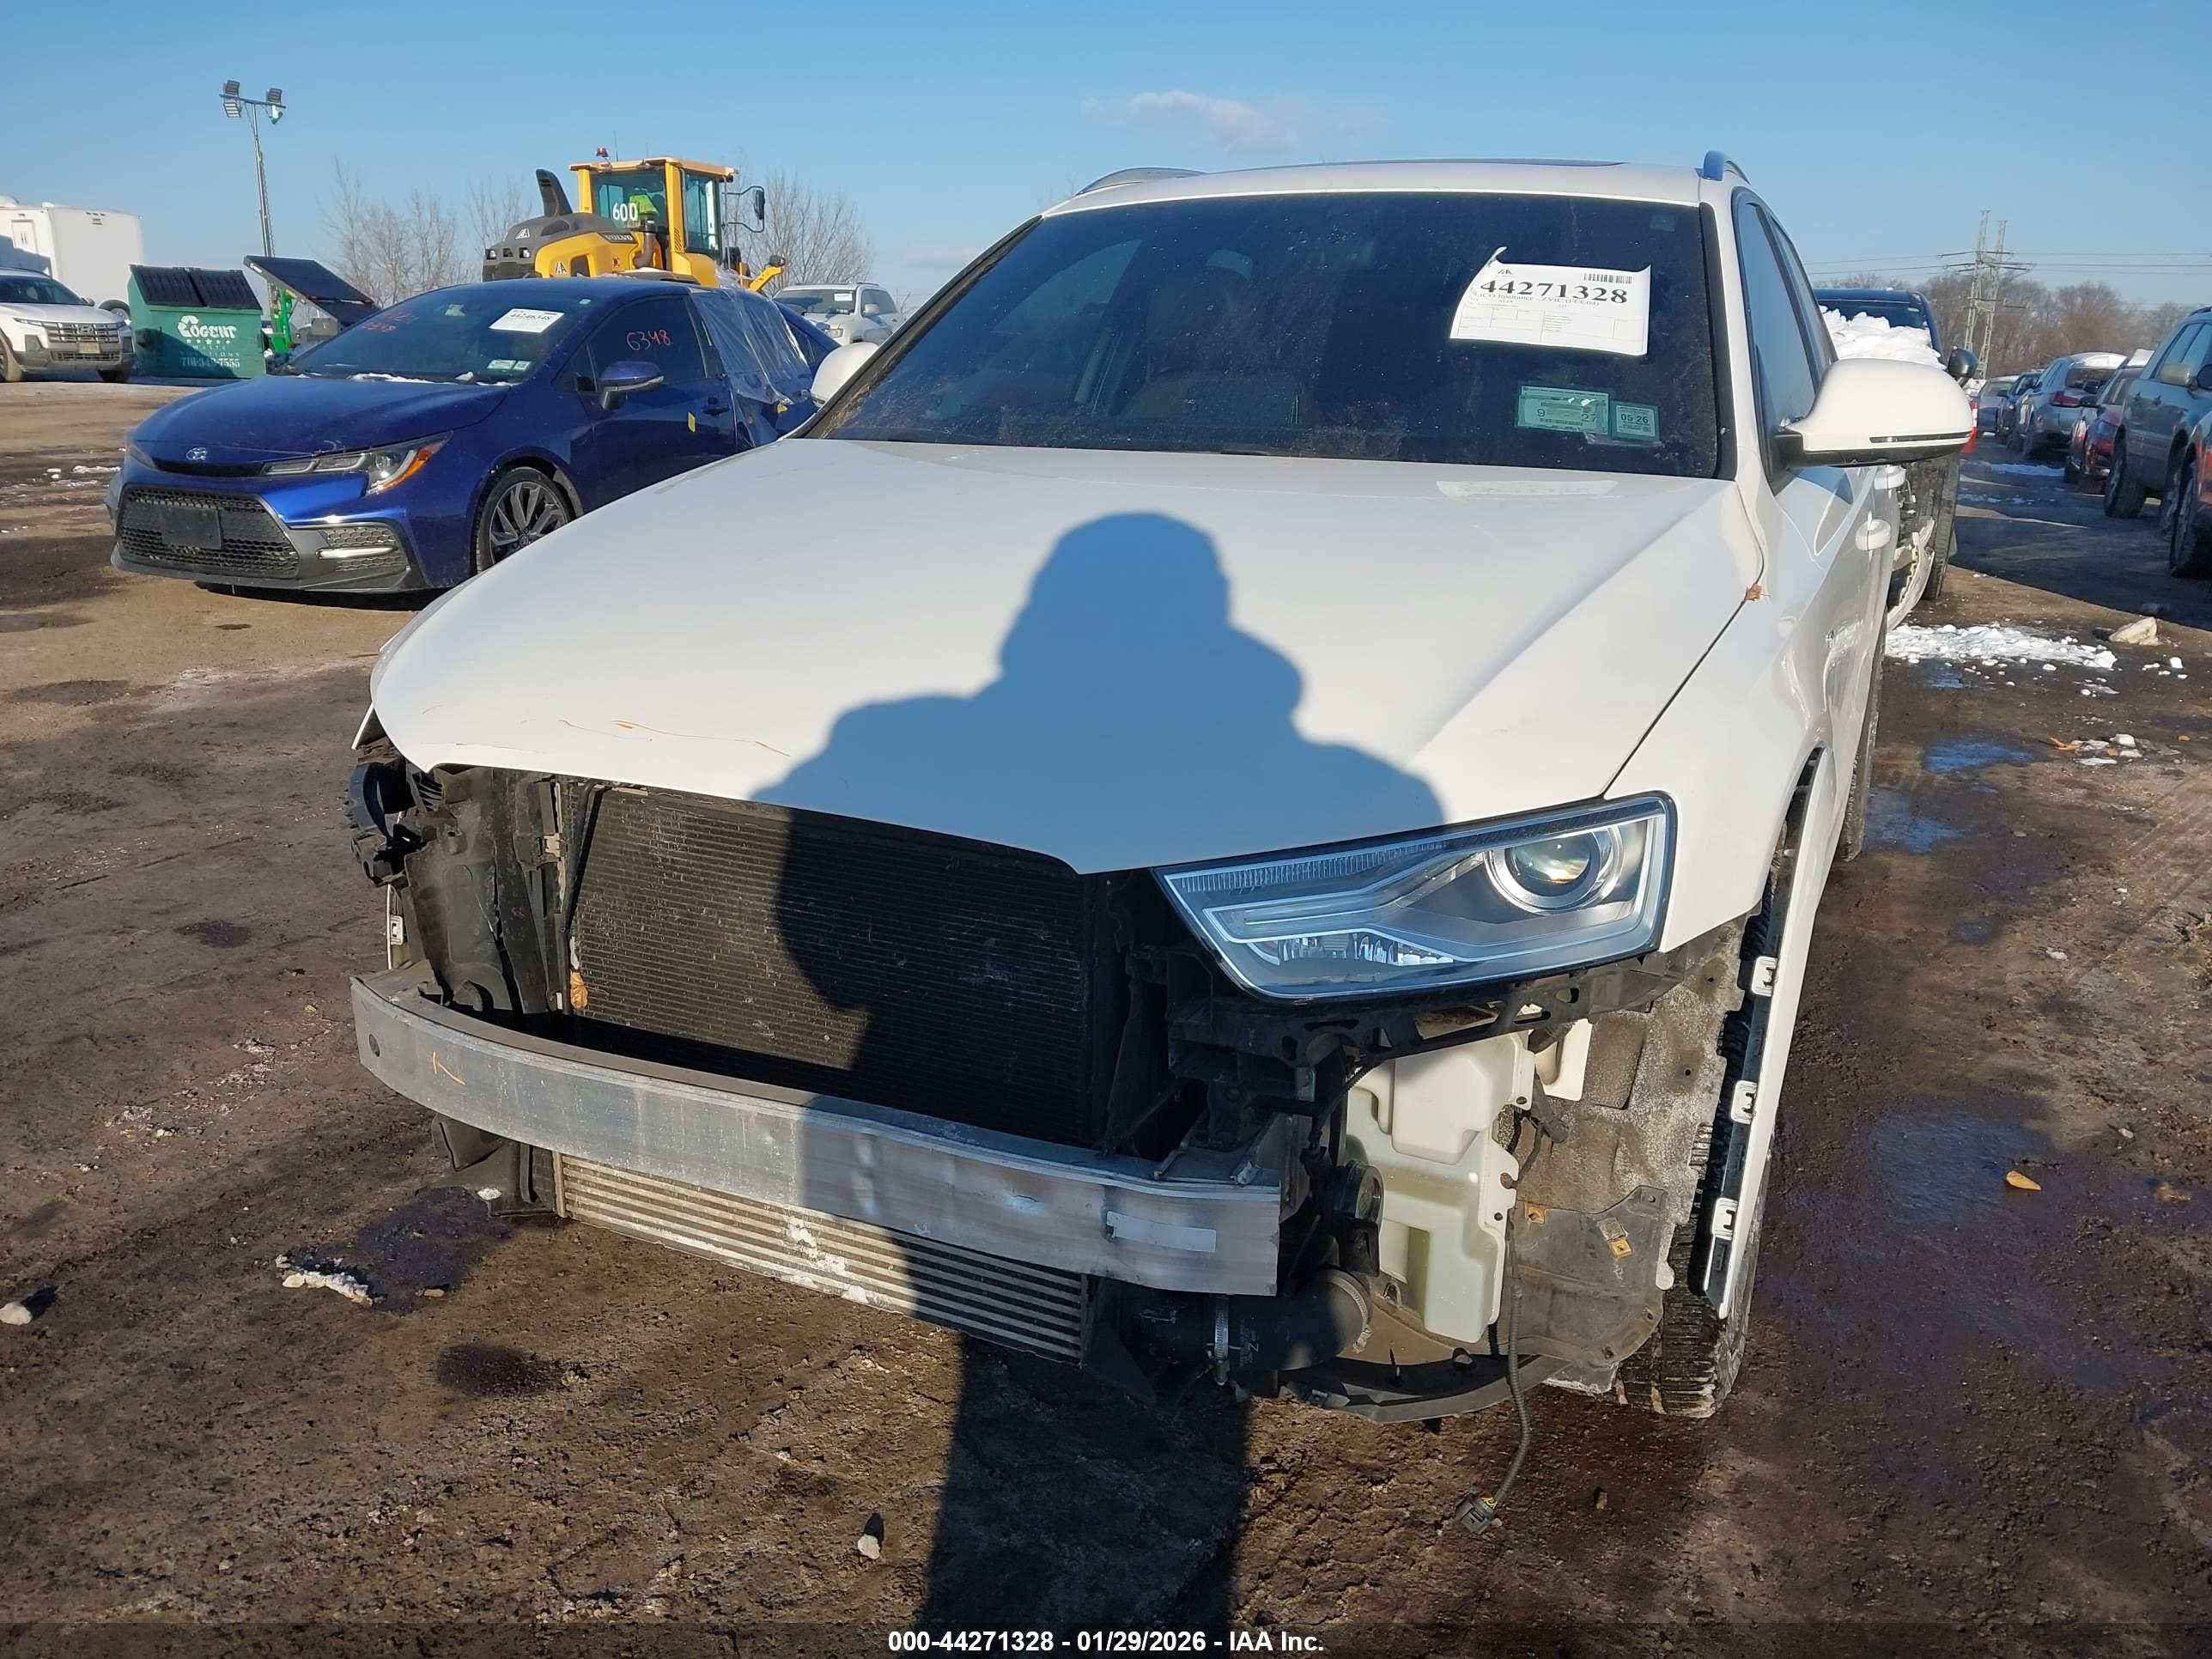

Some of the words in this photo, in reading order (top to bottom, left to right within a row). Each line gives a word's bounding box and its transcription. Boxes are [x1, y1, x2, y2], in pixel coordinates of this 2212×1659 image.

[1480, 280, 1628, 304] 44271328
[177, 315, 237, 339] COGENT
[627, 330, 671, 350] 6348
